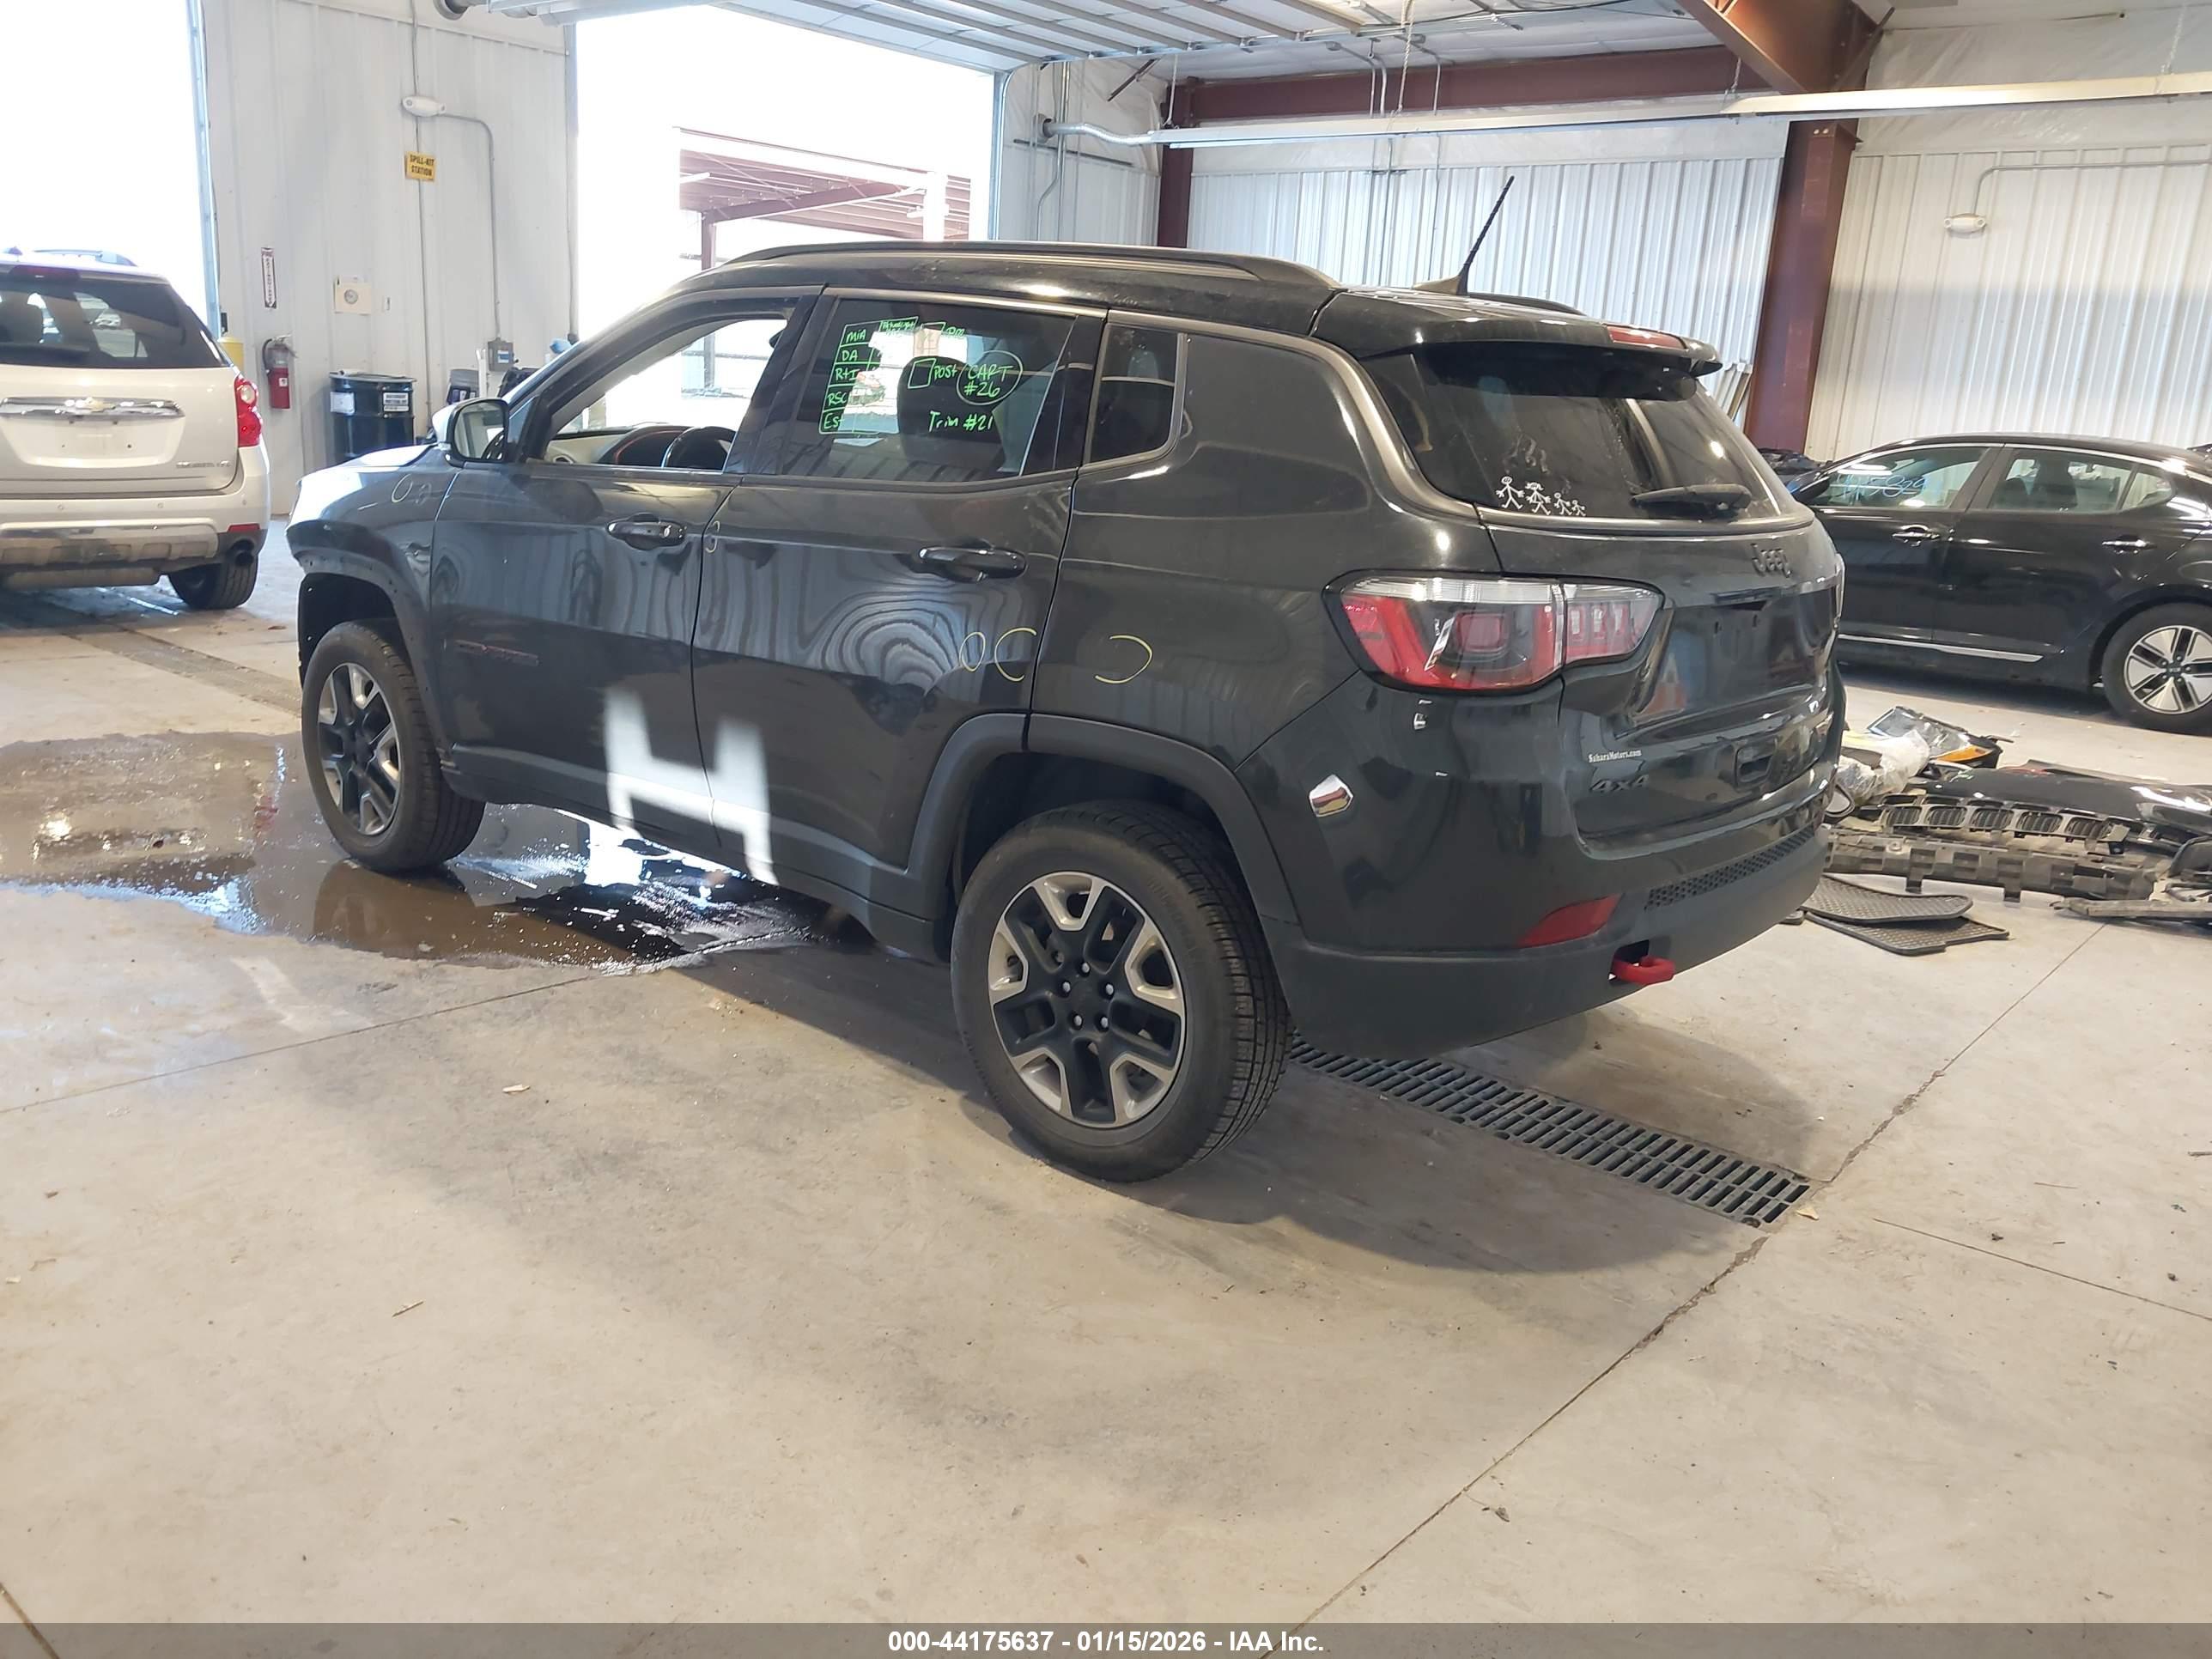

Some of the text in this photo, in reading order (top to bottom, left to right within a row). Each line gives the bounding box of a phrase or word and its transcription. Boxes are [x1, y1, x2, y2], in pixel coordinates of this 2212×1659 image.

[842, 349, 858, 361] DA
[968, 363, 1014, 382] CART
[963, 380, 1000, 398] #26
[929, 410, 994, 433] Trim #21
[1750, 543, 1792, 579] Jeep
